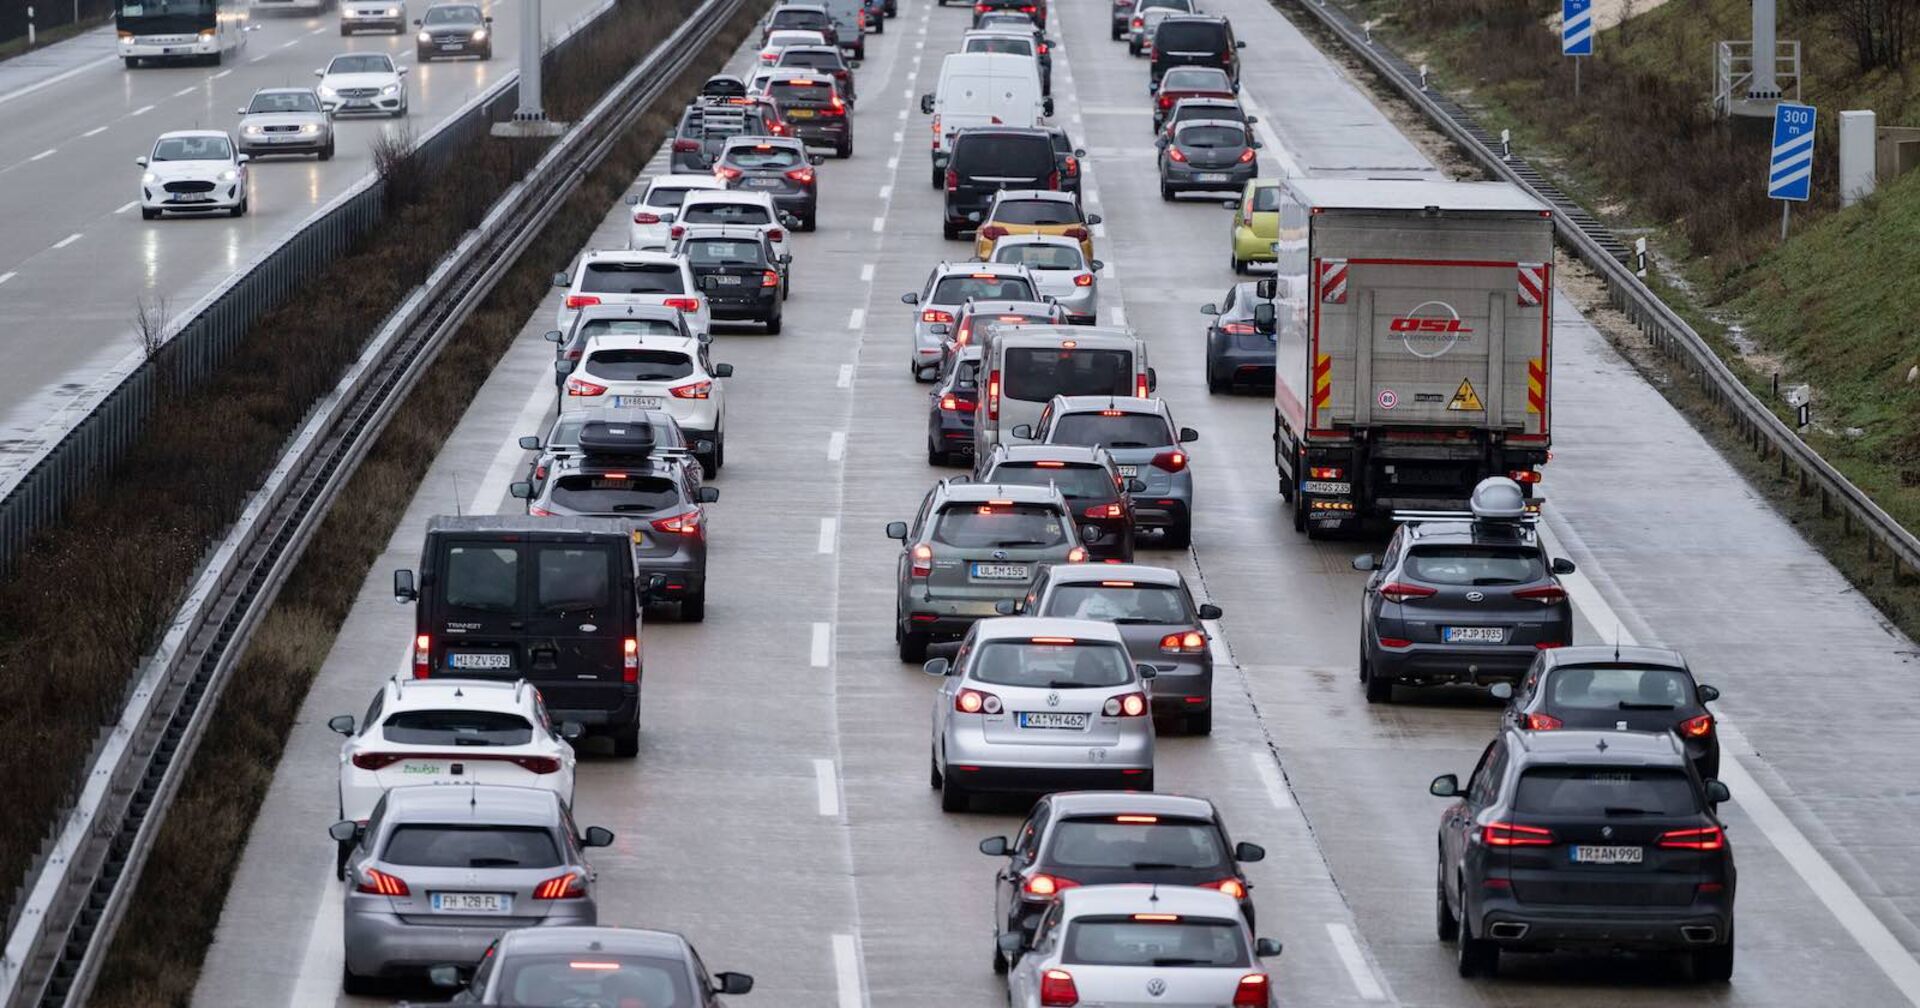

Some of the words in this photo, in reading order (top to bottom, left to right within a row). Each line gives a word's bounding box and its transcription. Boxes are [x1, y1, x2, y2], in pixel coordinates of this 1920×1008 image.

[1783, 110, 1808, 124] 300
[1789, 126, 1800, 134] m
[447, 622, 482, 630] TRANSIT
[489, 655, 508, 666] 593
[1028, 713, 1041, 724] KA
[1048, 714, 1062, 725] YH
[1064, 714, 1084, 725] 462
[1579, 847, 1593, 858] TR
[1601, 847, 1616, 859] AN
[443, 895, 457, 907] FH
